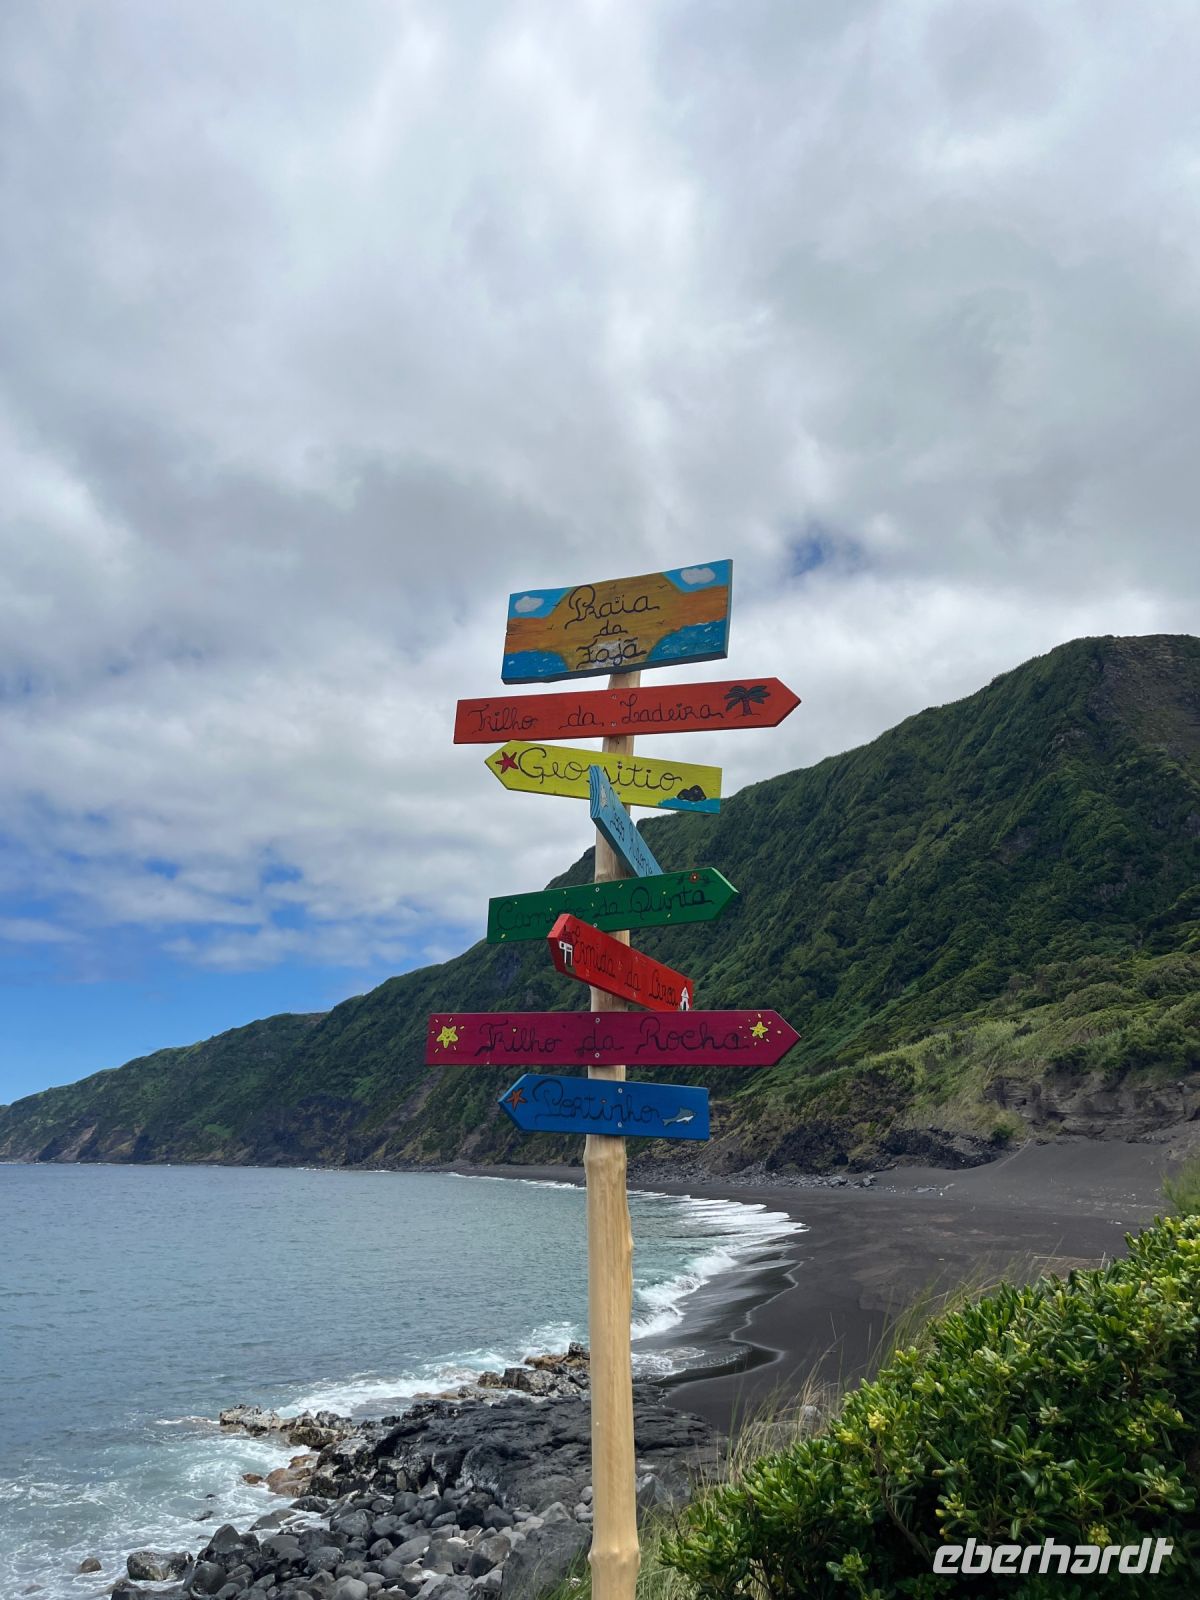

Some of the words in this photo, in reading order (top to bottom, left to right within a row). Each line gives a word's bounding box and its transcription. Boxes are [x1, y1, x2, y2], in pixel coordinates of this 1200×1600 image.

[565, 585, 660, 629] Praia
[593, 620, 628, 638] da
[576, 637, 648, 669] Fajã
[468, 704, 538, 734] Trilho
[559, 705, 604, 730] da
[620, 693, 724, 724] Ladeira
[518, 747, 682, 791] Geositio
[593, 897, 625, 918] da
[628, 886, 714, 920] Quinta
[571, 926, 616, 979] Ermida
[624, 960, 641, 991] da
[474, 1020, 562, 1057] Trilho
[575, 1025, 625, 1058] da
[635, 1016, 751, 1055] Rocha
[532, 1078, 660, 1125] Portinho
